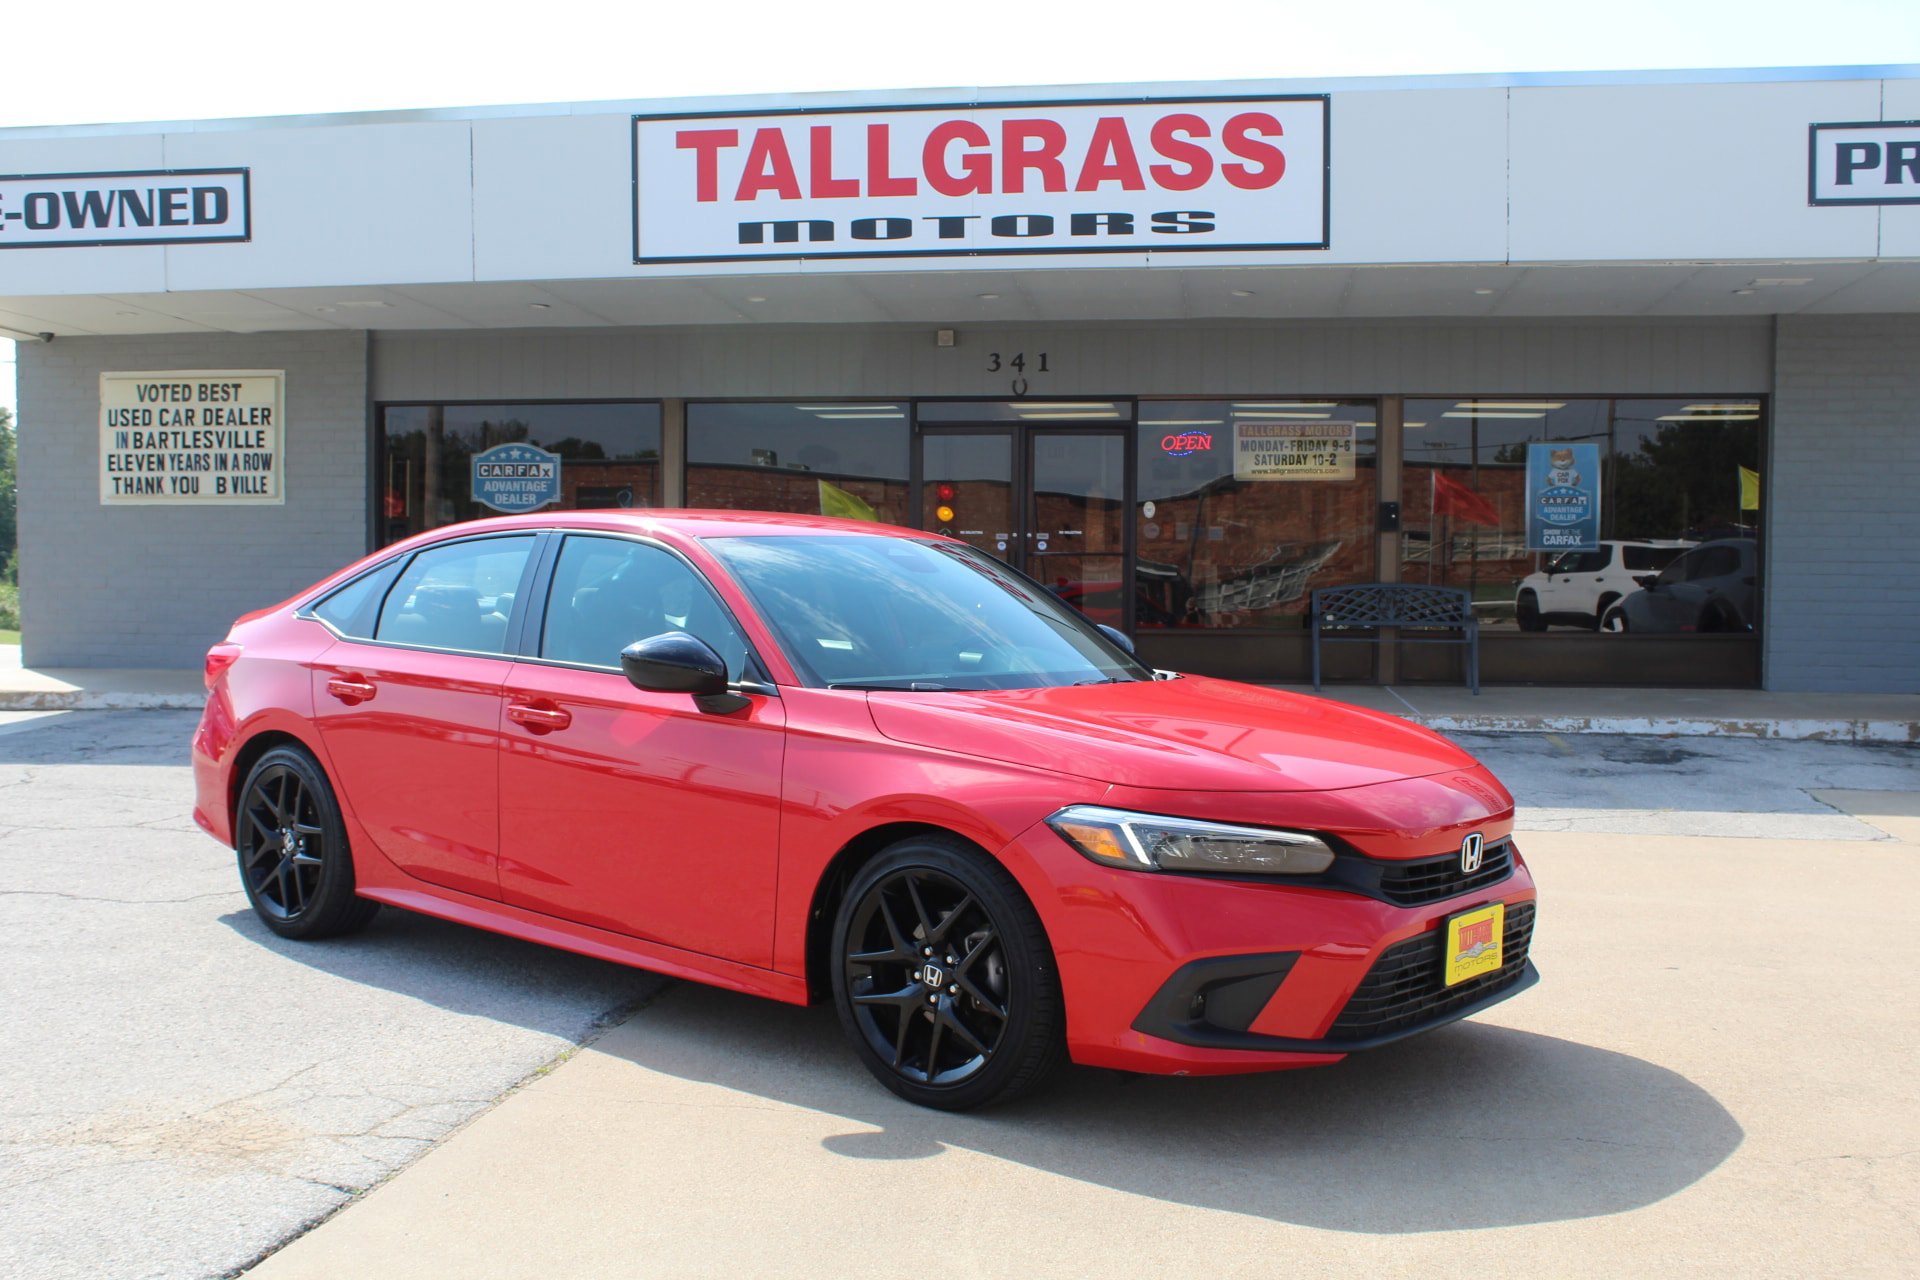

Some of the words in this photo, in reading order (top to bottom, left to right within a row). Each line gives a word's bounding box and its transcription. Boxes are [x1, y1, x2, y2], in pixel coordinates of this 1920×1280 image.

[675, 112, 1287, 203] TALLGRASS
[136, 384, 192, 403] VOTED
[198, 383, 242, 402] BEST
[108, 408, 152, 427] USED
[159, 408, 195, 427] CAR
[203, 407, 272, 426] DEALER
[1241, 425, 1301, 437] TALLGRASS
[1304, 424, 1351, 437] MOTORS
[116, 431, 129, 449] IN
[133, 430, 265, 449] BARTLESVILLE
[1160, 434, 1213, 451] OPEN
[1240, 439, 1328, 452] MONDAY-FRIDAY
[108, 453, 165, 472] ELEVEN
[169, 453, 210, 471] YEARS
[214, 453, 228, 471] IN
[231, 453, 240, 471] A
[243, 452, 273, 471] ROW
[1254, 453, 1308, 466] SATURDAY
[1312, 452, 1337, 466] 10-2
[479, 464, 552, 478] CARFAX
[112, 476, 164, 495] THANK
[170, 476, 199, 494] YOU
[216, 476, 227, 494] B
[231, 476, 268, 494] VILLE
[483, 481, 547, 492] ADVANTAGE
[494, 493, 537, 505] DEALER
[1543, 506, 1584, 514] ADVANTAGE
[1550, 513, 1577, 521] DEALER
[1543, 535, 1582, 545] CARFAX
